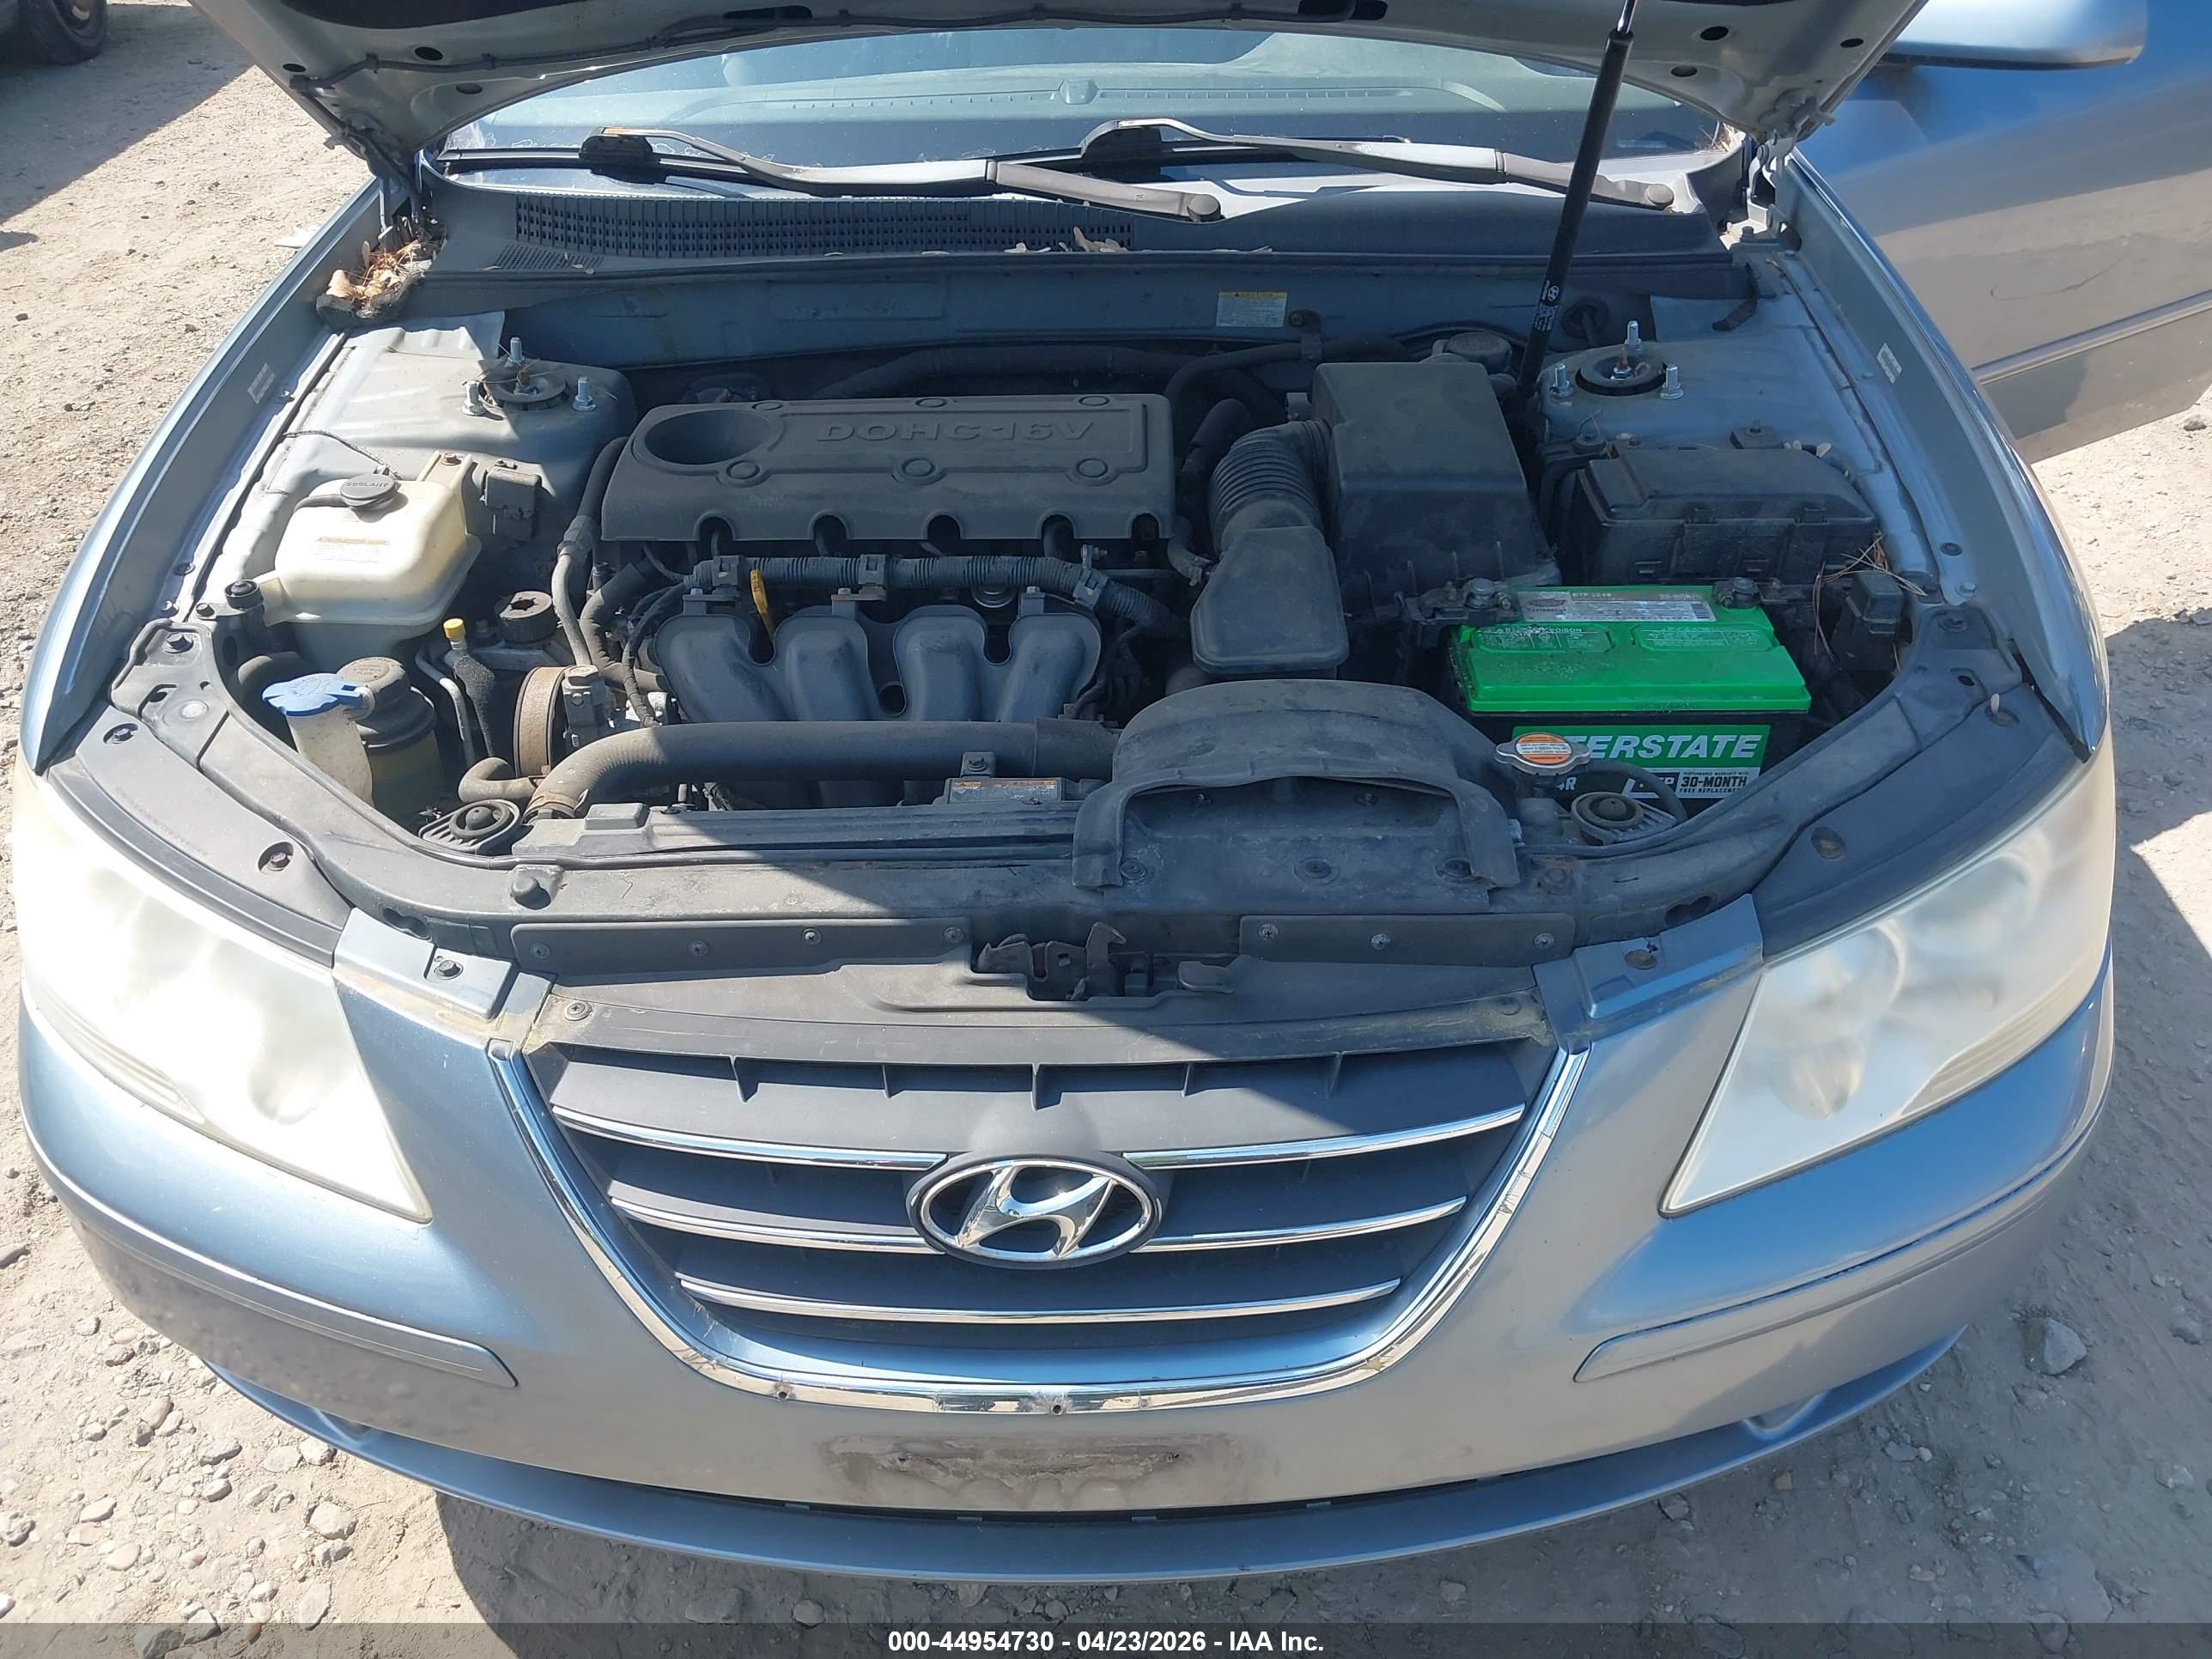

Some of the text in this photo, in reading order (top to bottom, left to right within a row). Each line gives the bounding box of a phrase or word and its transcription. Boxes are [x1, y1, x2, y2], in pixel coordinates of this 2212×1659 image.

[817, 422, 981, 441] DOHC
[1563, 735, 1762, 758] TERSTATE
[1681, 776, 1747, 787] 30-MONTH
